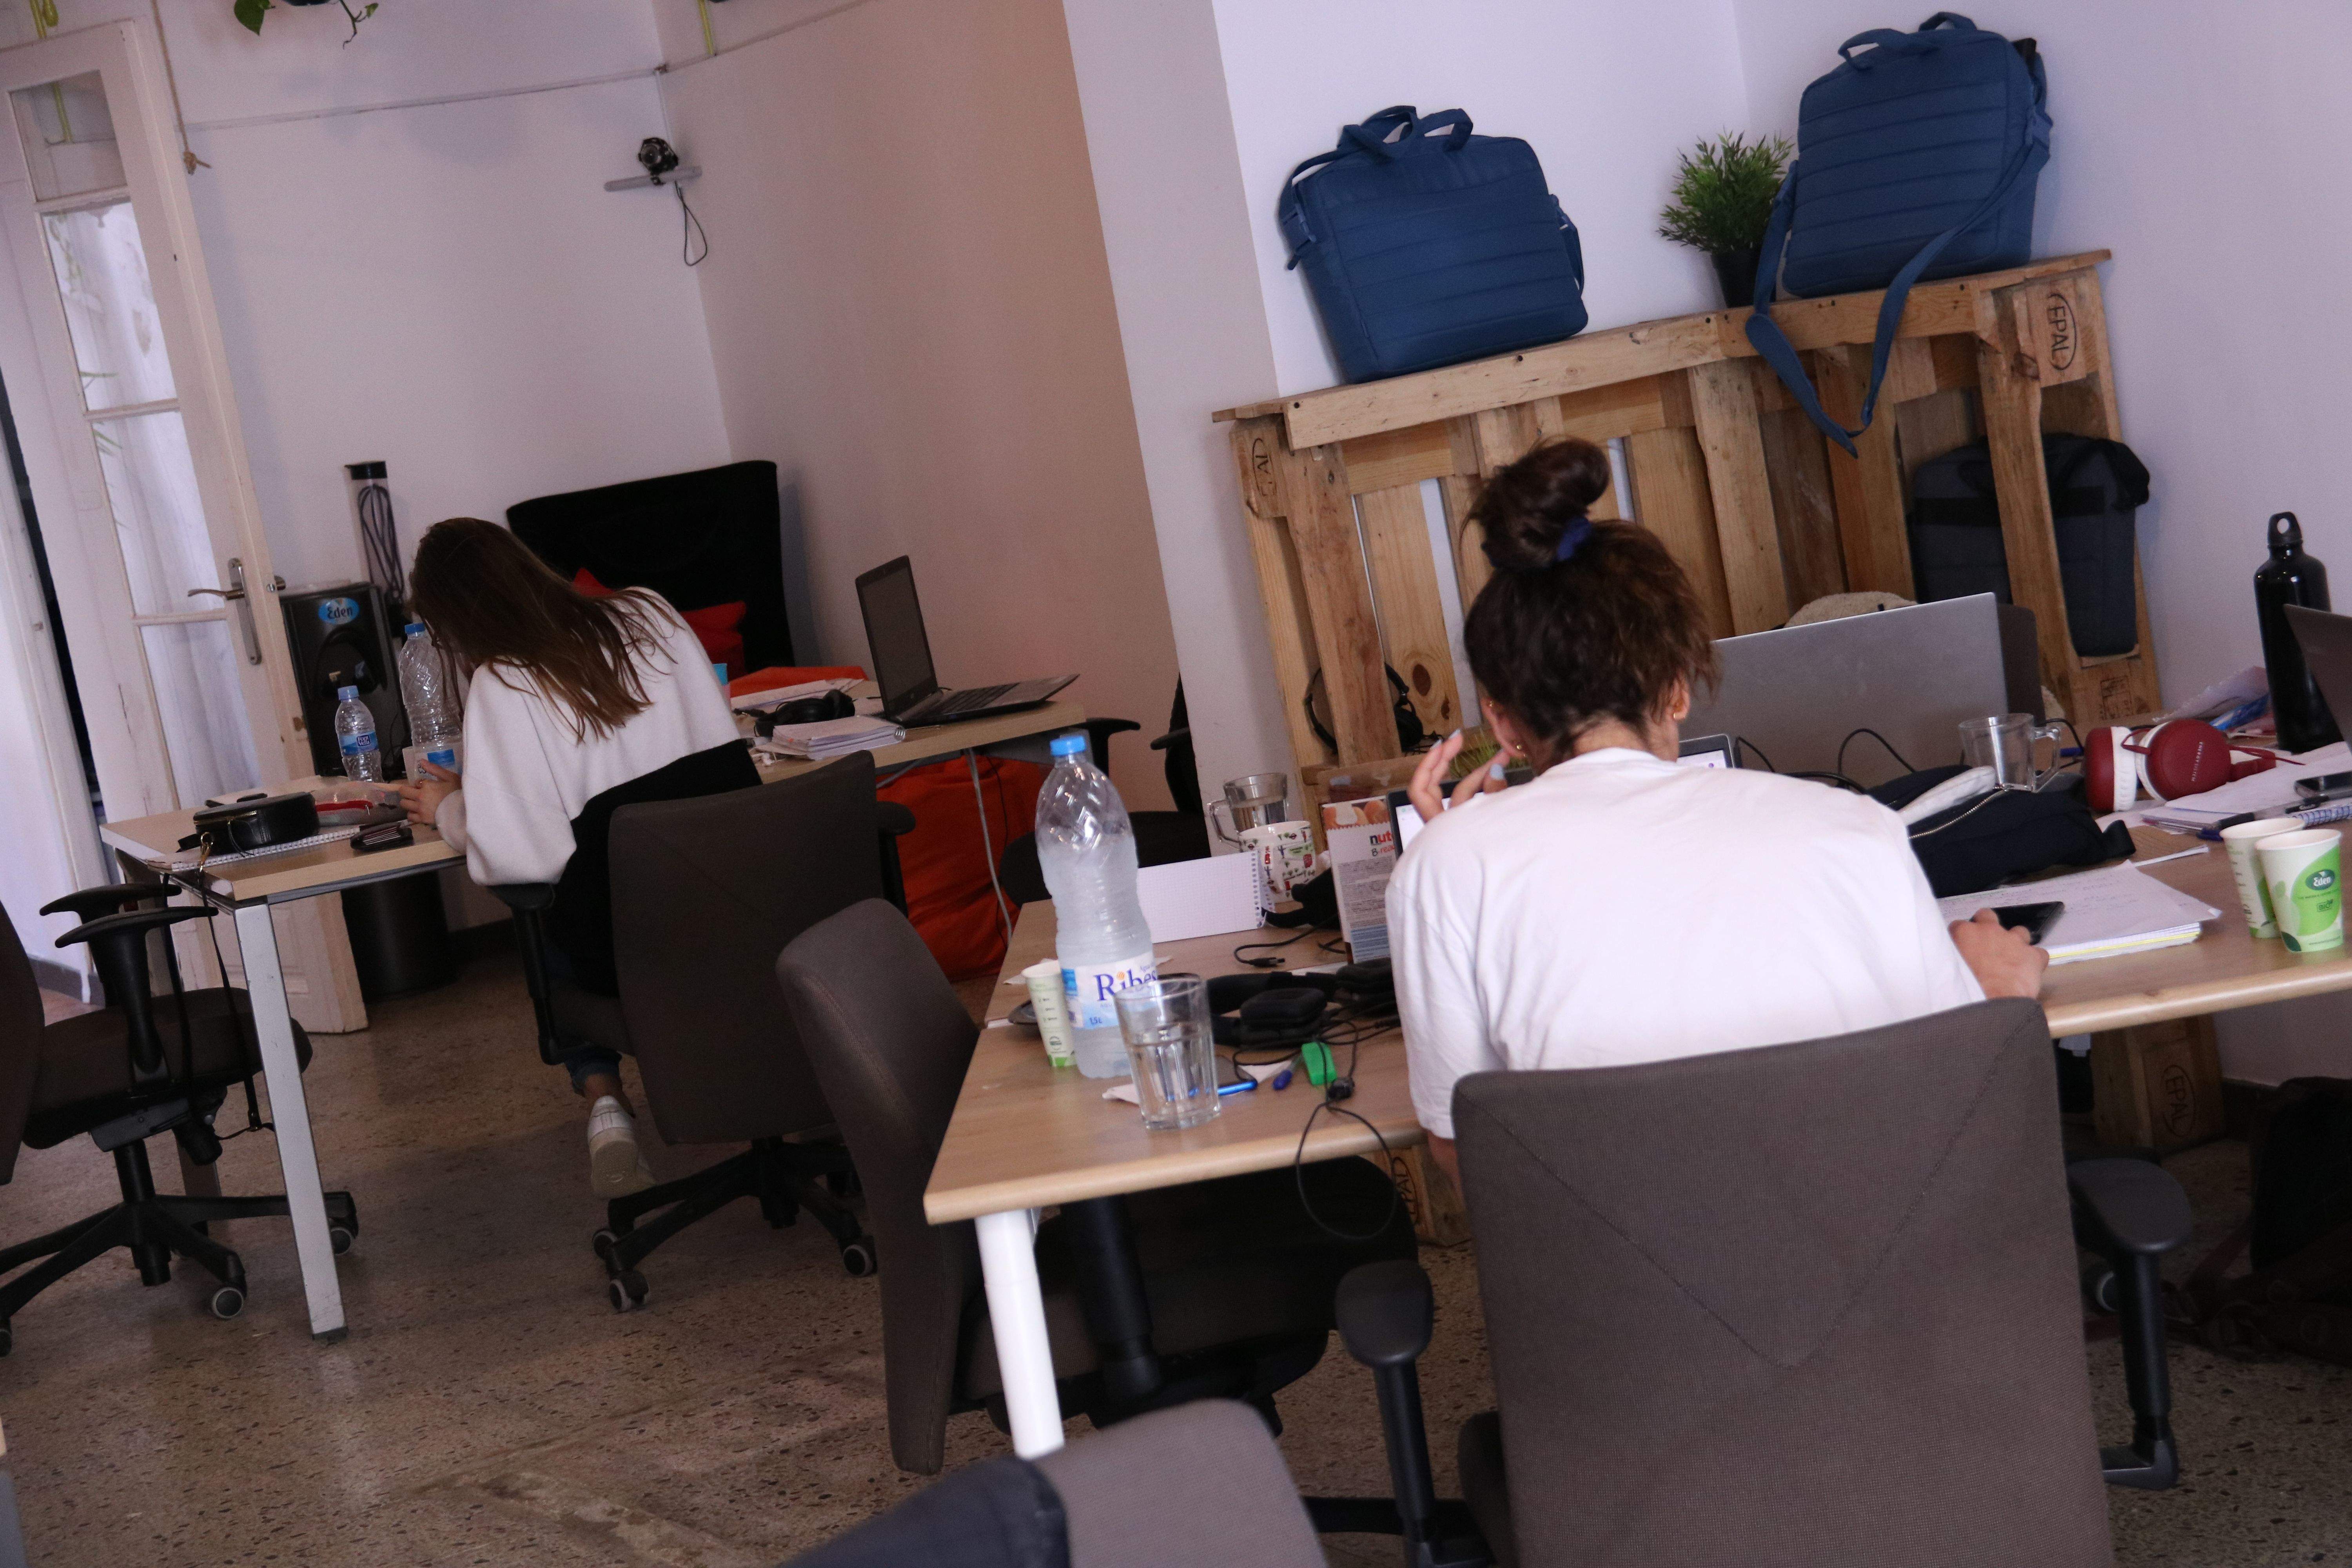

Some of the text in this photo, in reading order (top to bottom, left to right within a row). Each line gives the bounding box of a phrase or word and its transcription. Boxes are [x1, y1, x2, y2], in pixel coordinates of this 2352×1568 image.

[2048, 306, 2069, 360] EPAL
[327, 606, 352, 619] Eden
[1370, 831, 1392, 844] nut
[2165, 1075, 2189, 1131] EPAL
